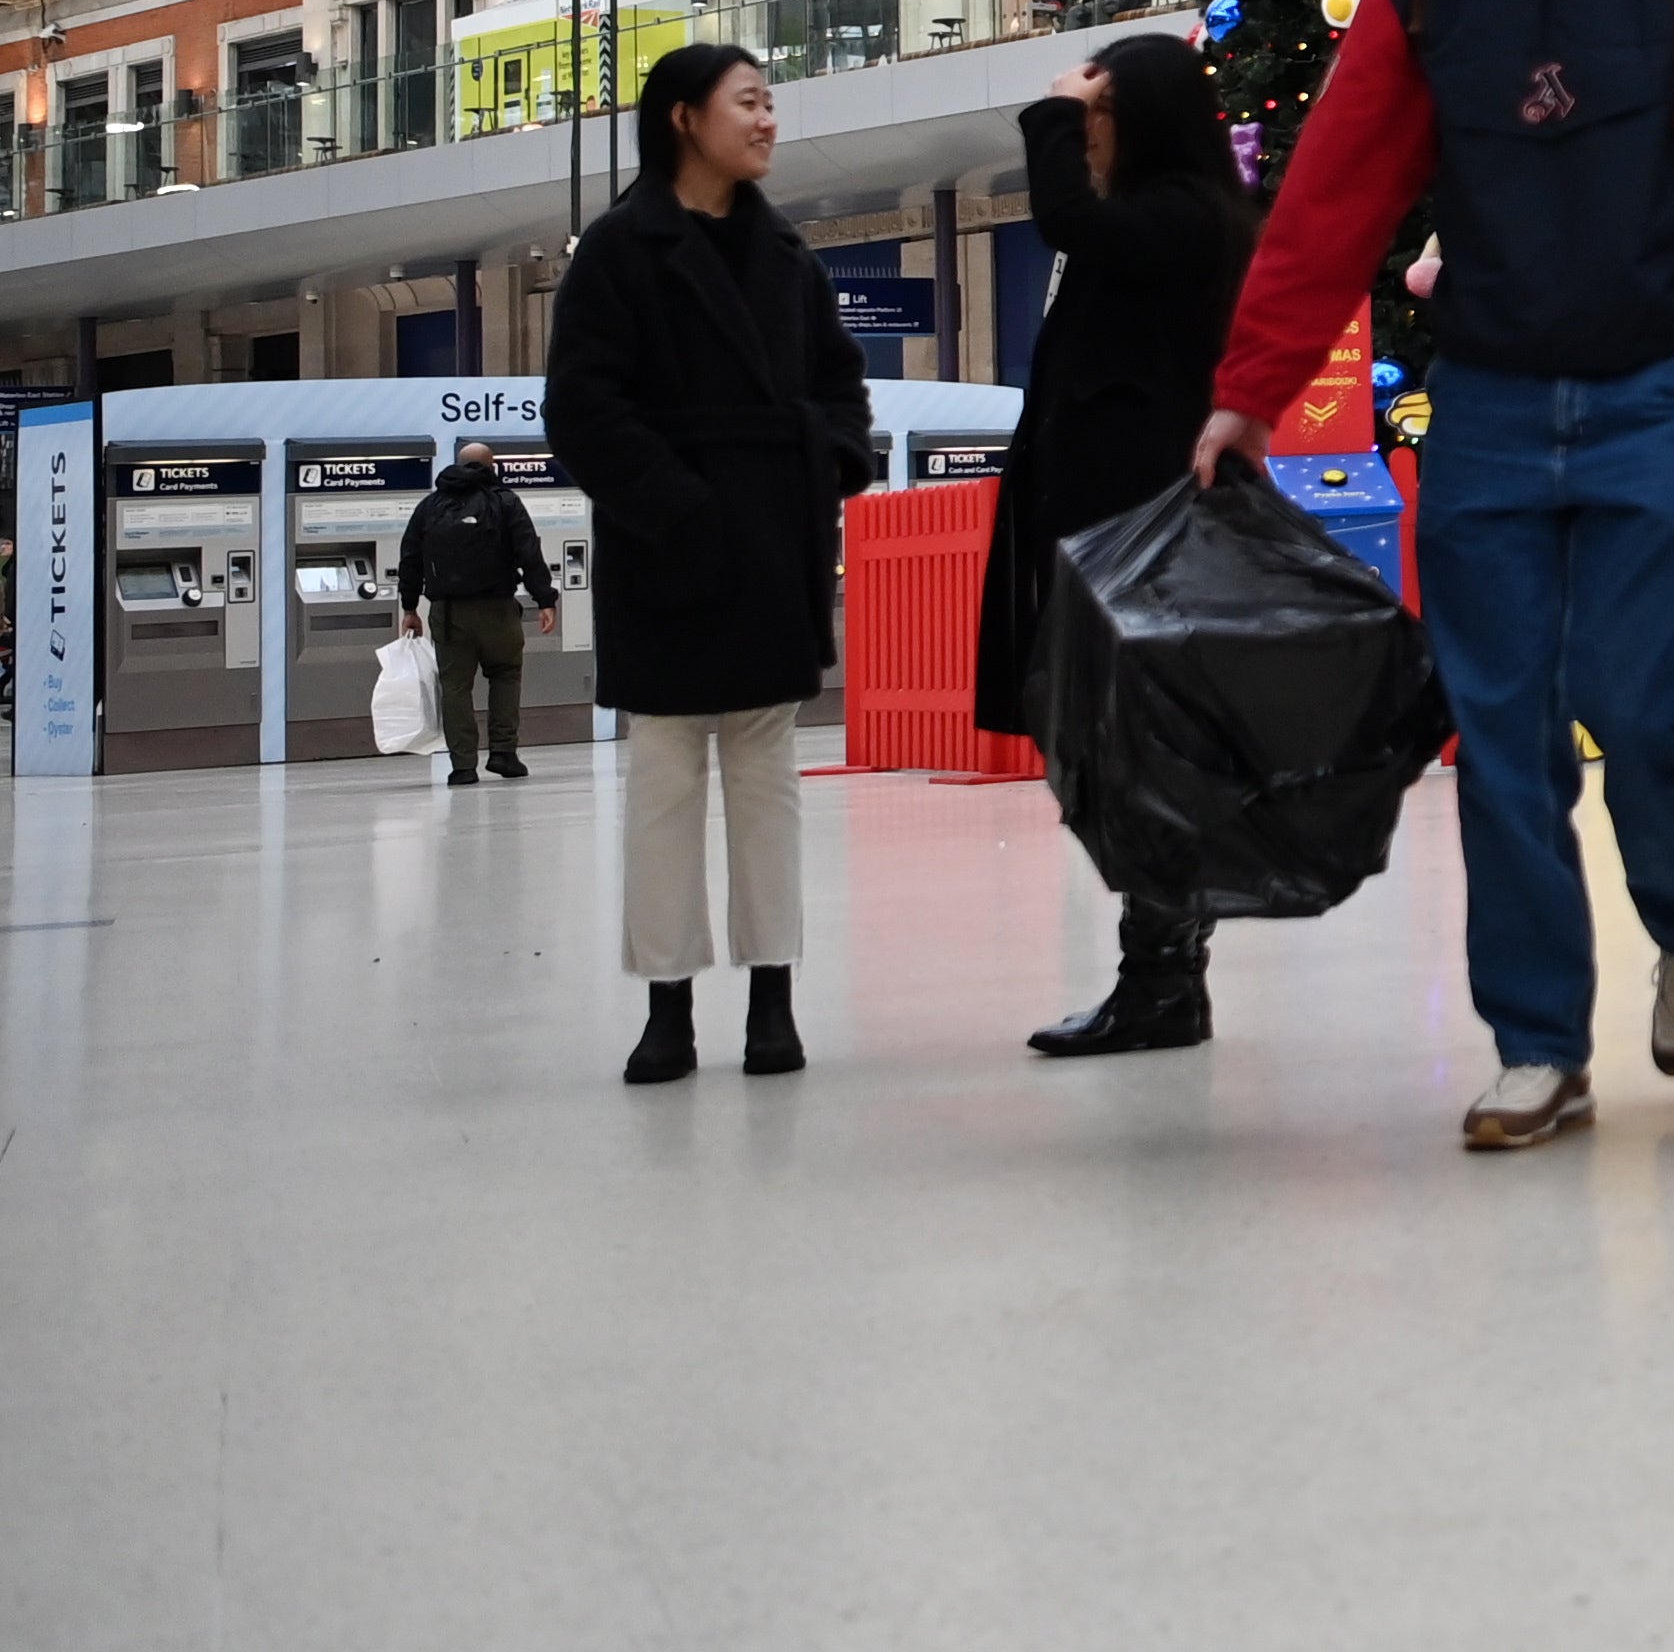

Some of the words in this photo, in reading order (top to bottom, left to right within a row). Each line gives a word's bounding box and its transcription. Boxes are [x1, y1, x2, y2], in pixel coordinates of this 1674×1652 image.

[948, 453, 986, 463] TICKETS
[159, 467, 209, 479] TICKETS
[324, 463, 376, 475] TICKETS
[502, 461, 546, 473] TICKETS
[324, 478, 344, 487] Card
[346, 477, 385, 488] Payments
[502, 476, 518, 484] Card
[520, 476, 555, 485] Payments
[159, 482, 178, 491] Card
[180, 482, 218, 492] Payments
[52, 451, 66, 622] TICKETS
[48, 675, 62, 691] Buy
[48, 698, 75, 713] Collect
[48, 722, 73, 738] Oyster
